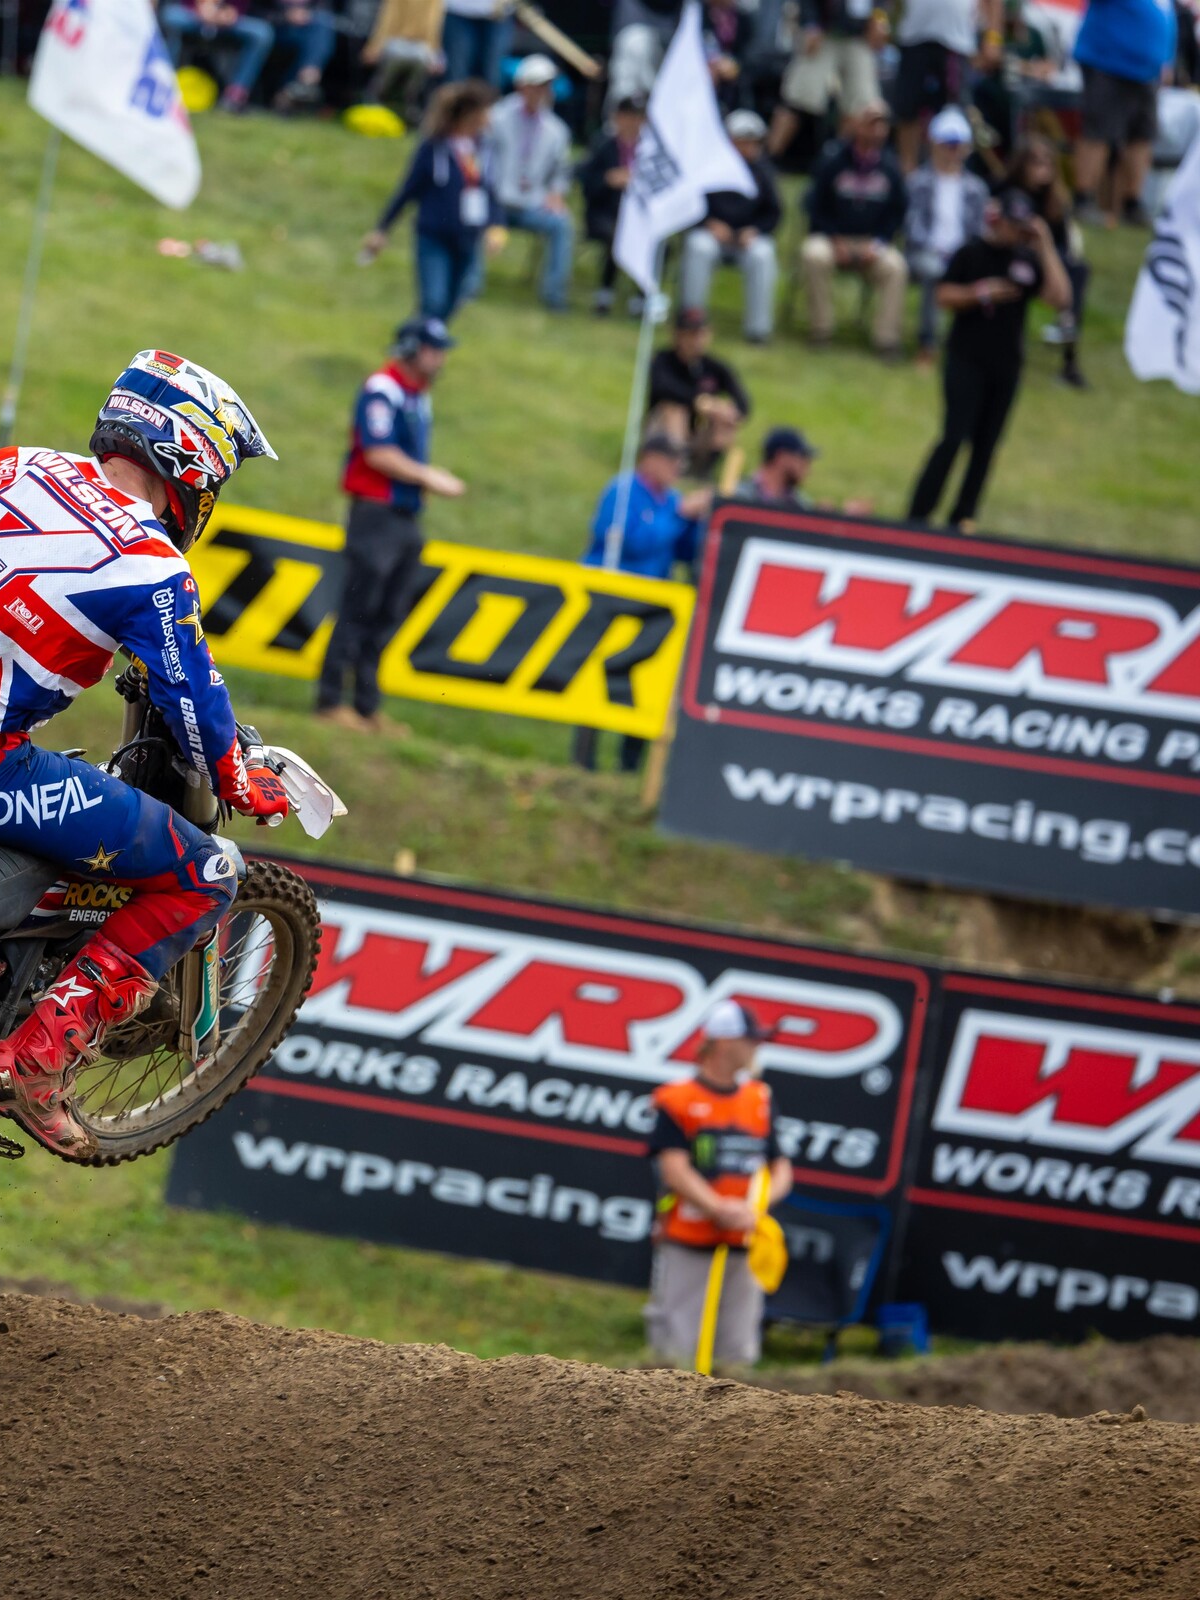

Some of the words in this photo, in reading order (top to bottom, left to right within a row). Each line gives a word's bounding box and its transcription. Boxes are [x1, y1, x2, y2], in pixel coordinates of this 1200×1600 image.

[109, 394, 168, 430] WILSON
[26, 452, 147, 546] WILSON
[159, 607, 186, 682] Husqvarna
[199, 529, 676, 707] THOR
[180, 696, 203, 752] GREAT
[714, 664, 923, 729] WORKS
[931, 697, 1149, 762] RACING
[1156, 730, 1200, 772] P
[63, 882, 134, 909] ROCKS
[232, 900, 902, 1080] WRP
[274, 1034, 441, 1095] ORKS
[445, 1061, 659, 1133] RACING
[774, 1115, 880, 1169] RTS
[231, 1131, 653, 1242] wrpracing
[932, 1143, 1151, 1210] WORKS
